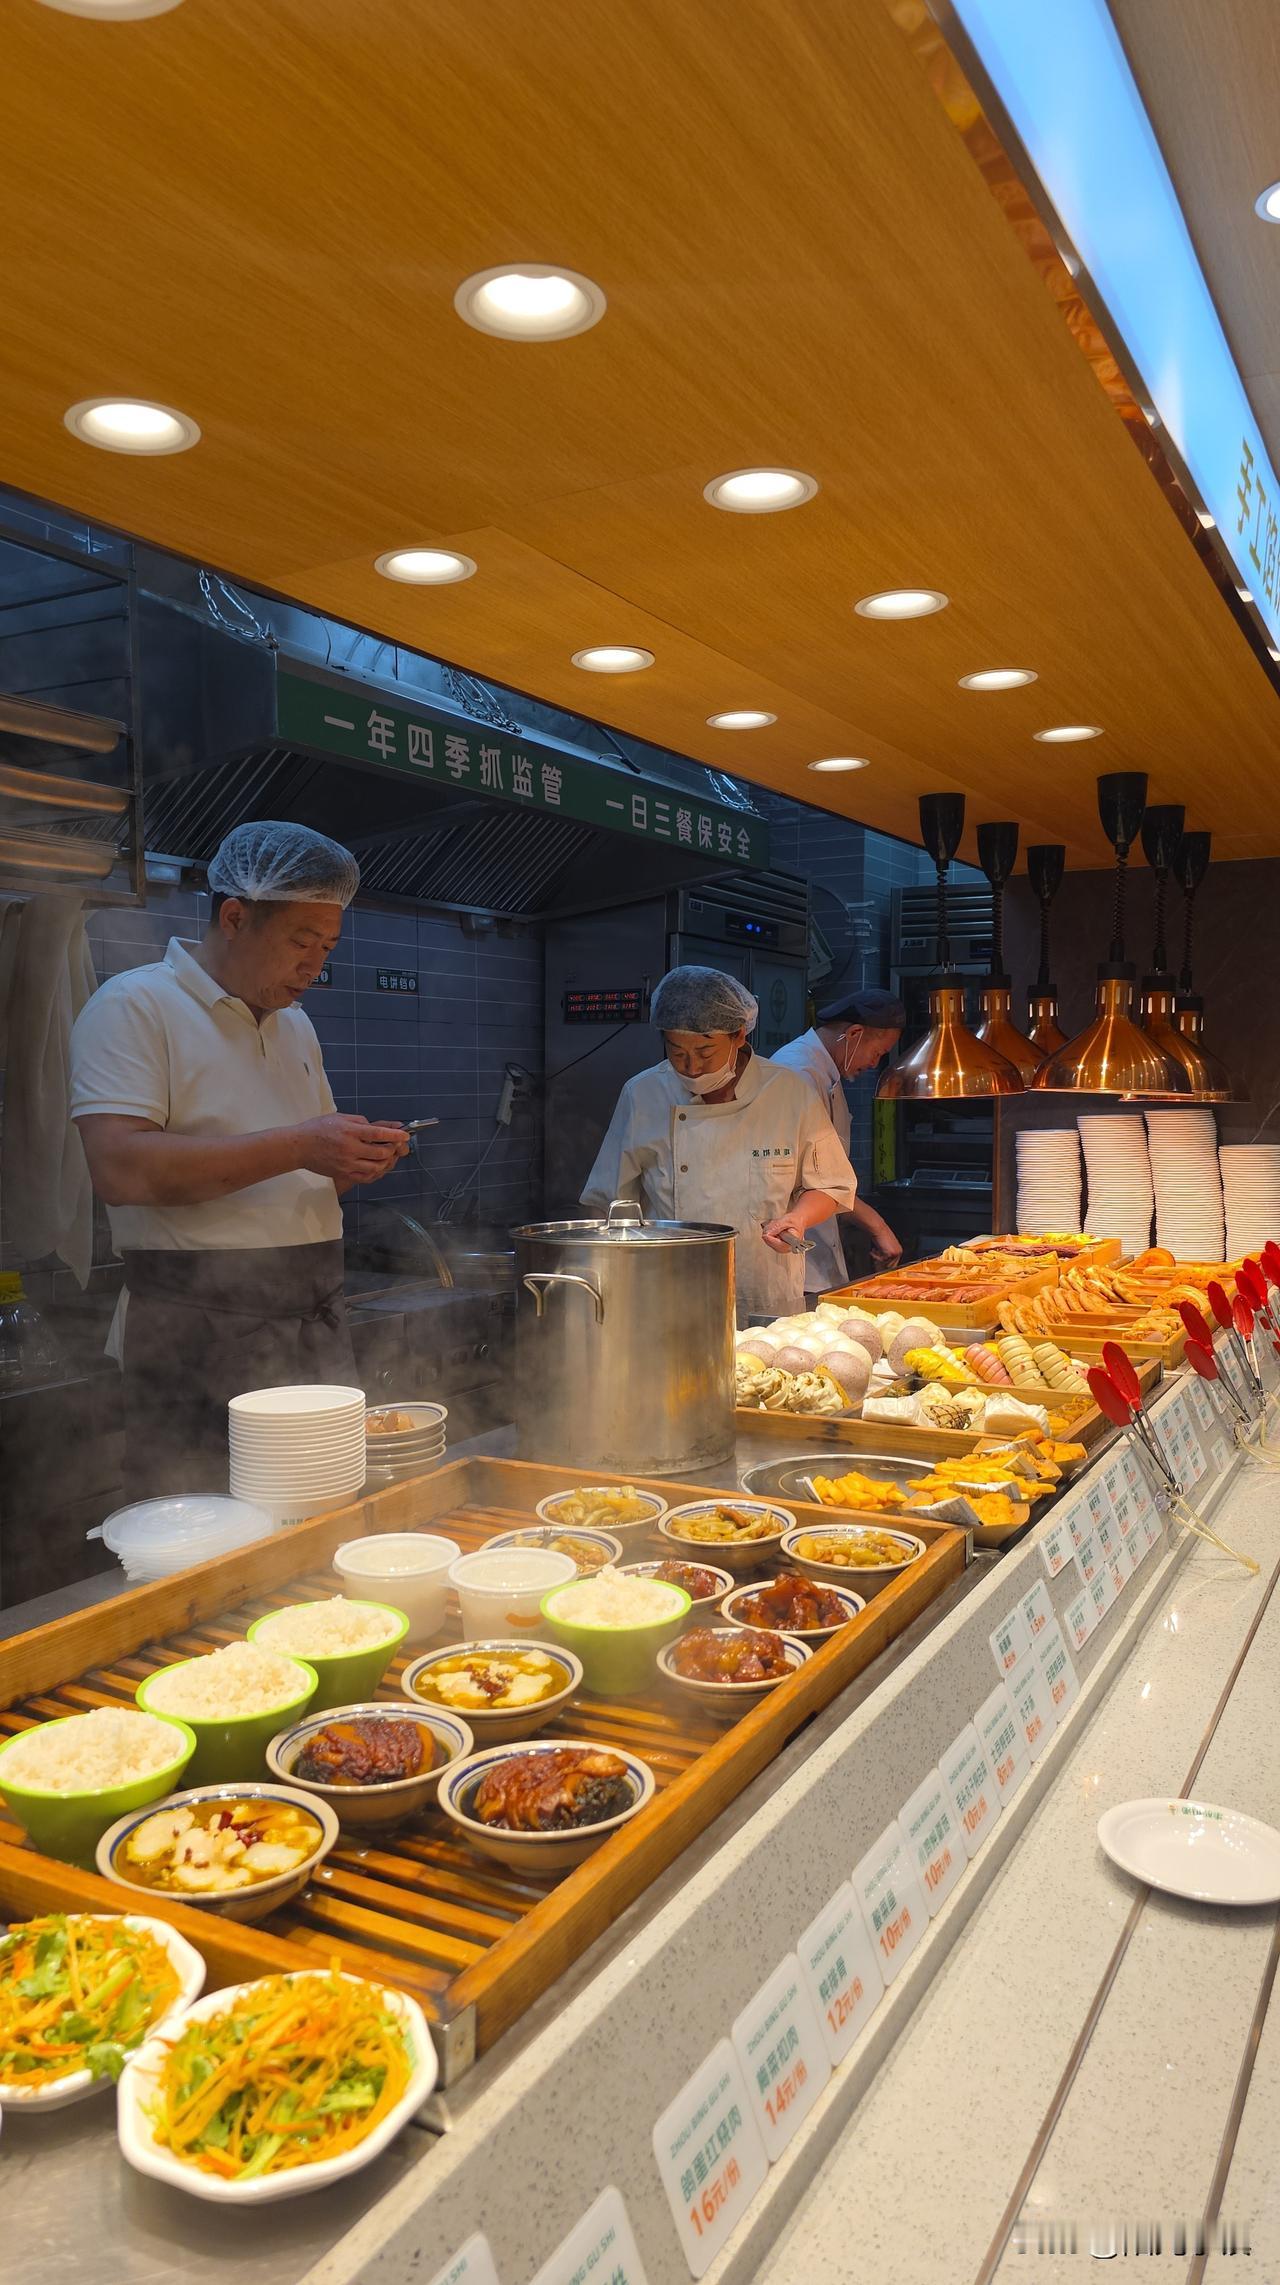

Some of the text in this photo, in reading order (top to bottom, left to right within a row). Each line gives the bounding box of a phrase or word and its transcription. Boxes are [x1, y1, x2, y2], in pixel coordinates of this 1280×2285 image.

[323, 708, 751, 860] 一年四季抓监管 一日三餐保安全
[924, 1847, 952, 1893] 10元/份
[880, 1905, 912, 1958] 10元/份
[827, 1975, 864, 2035] 12元/份
[670, 2072, 731, 2160] ZHOU BING GU SHI
[765, 2057, 808, 2129] 14元/份
[690, 2157, 741, 2238] 16元/份
[450, 2256, 468, 2283] SHI
[585, 2250, 601, 2271] GU
[600, 2225, 617, 2251] SHI
